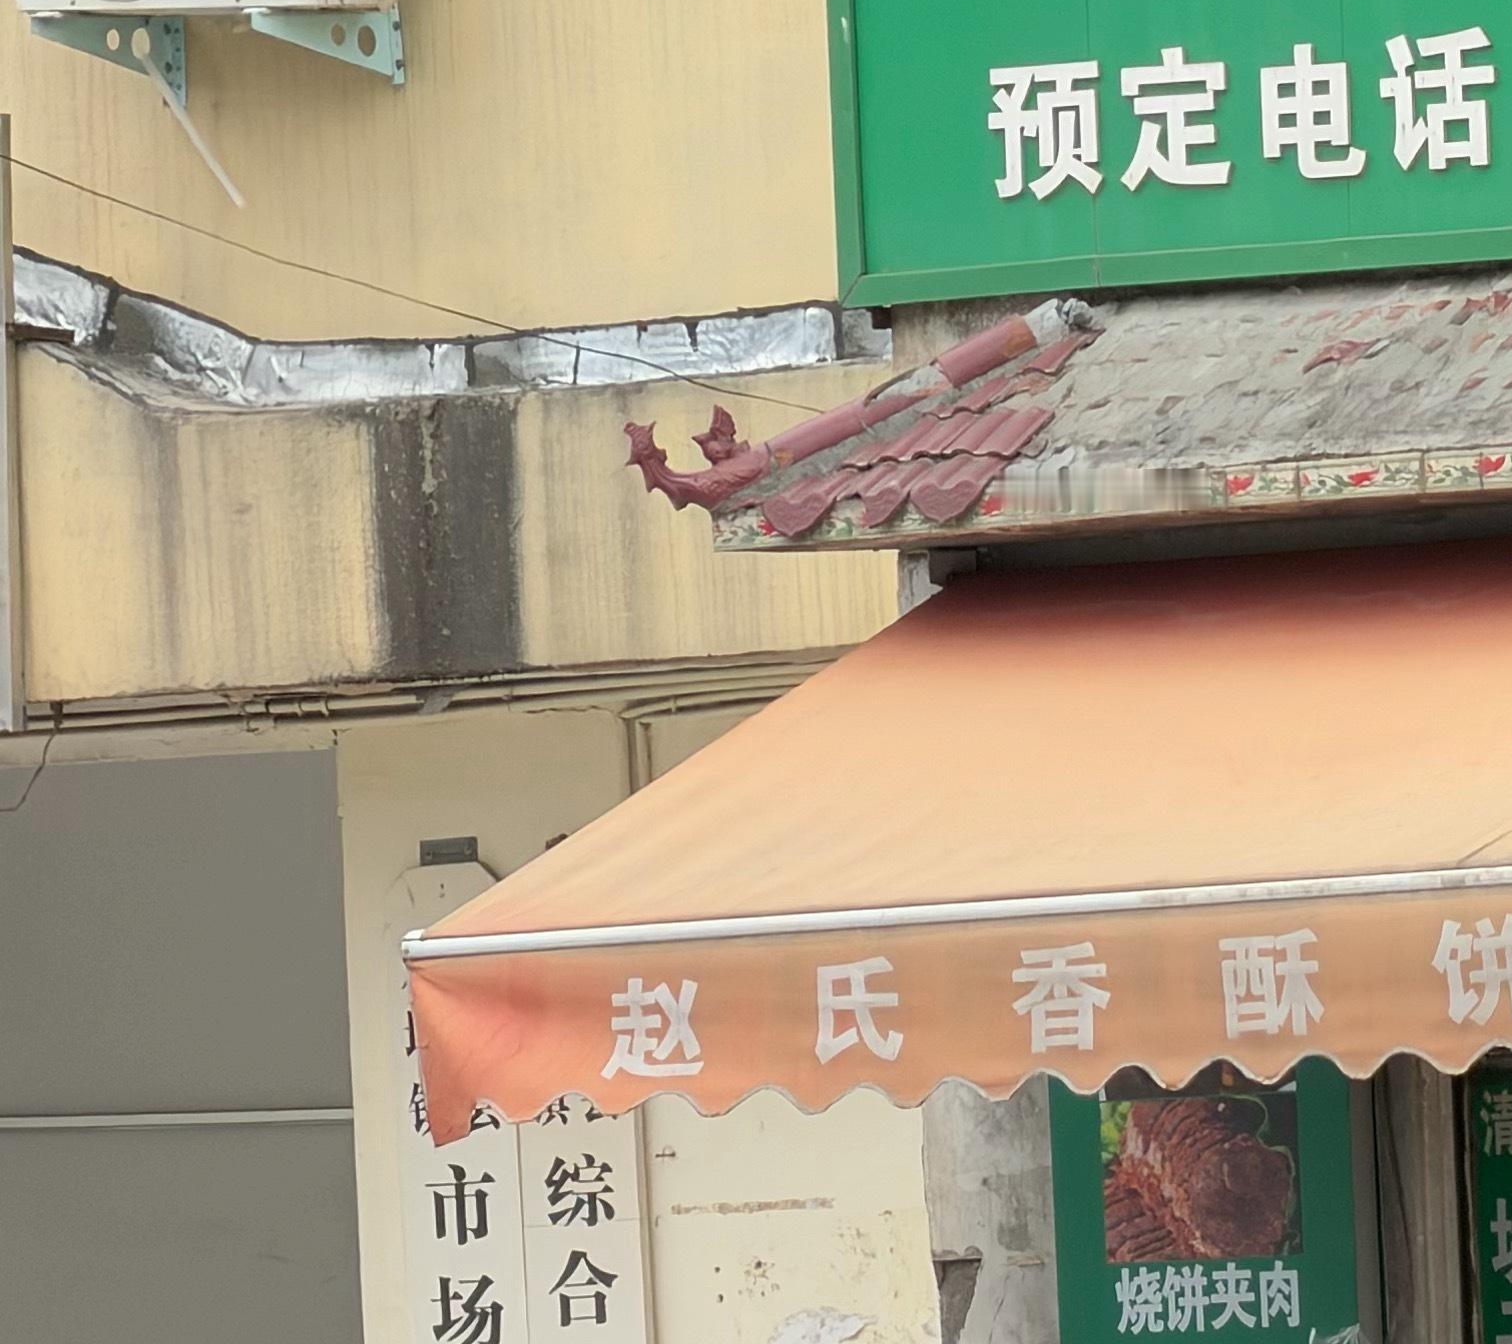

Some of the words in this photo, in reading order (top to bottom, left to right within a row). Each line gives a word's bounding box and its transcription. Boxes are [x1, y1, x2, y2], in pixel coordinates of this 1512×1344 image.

[987, 25, 1496, 200] 预定电话
[1116, 1260, 1302, 1335] 烧饼夹肉
